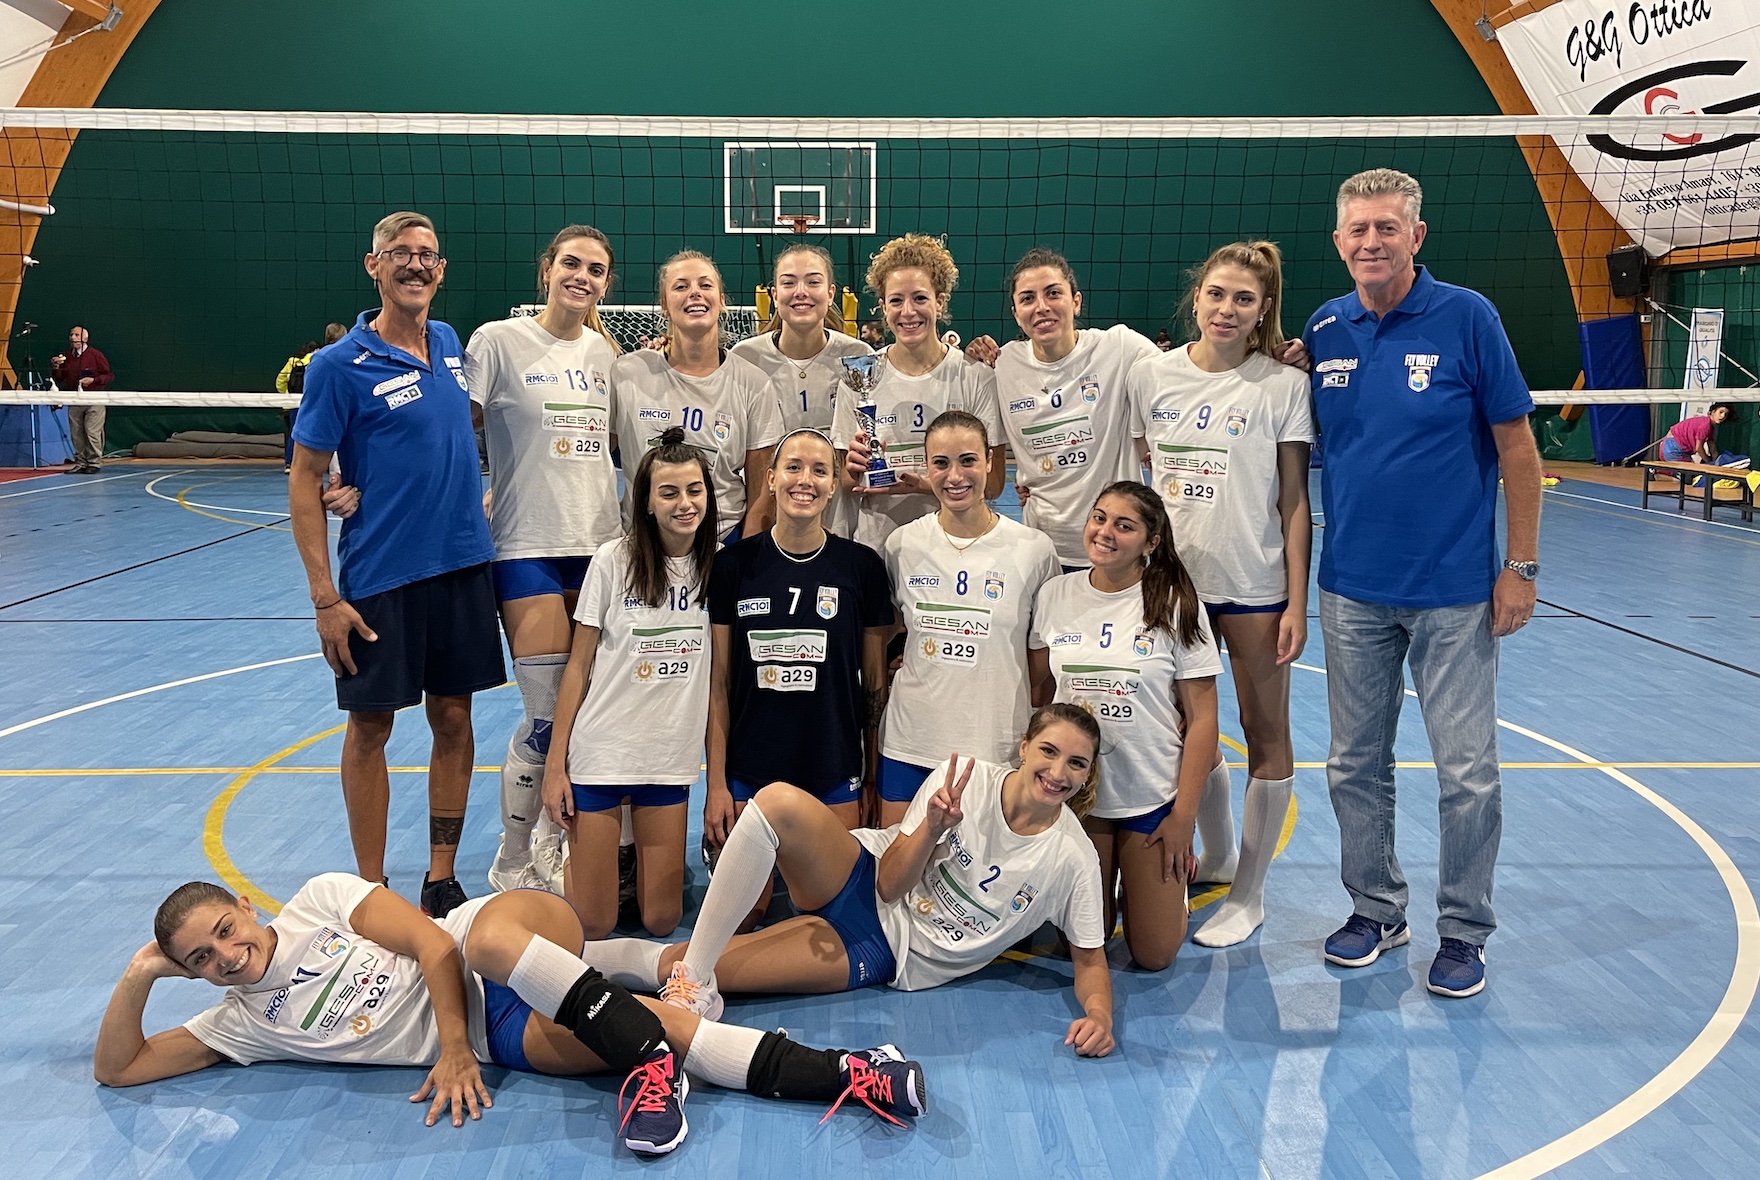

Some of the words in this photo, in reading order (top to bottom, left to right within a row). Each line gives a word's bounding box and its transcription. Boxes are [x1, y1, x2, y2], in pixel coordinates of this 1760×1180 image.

[1566, 10, 1623, 83] G&G
[1628, 0, 1712, 46] Ottica
[1620, 191, 1639, 203] Via
[1657, 196, 1682, 212] 091
[1683, 192, 1705, 205] 661
[525, 374, 558, 384] RMC101
[564, 368, 589, 392] 13
[799, 389, 808, 412] 1
[1009, 400, 1036, 412] RMC101
[1050, 388, 1063, 409] 6
[553, 414, 607, 427] GESAN
[640, 410, 671, 420] RMC101
[682, 405, 704, 432] 10
[874, 415, 897, 425] MC101
[913, 404, 925, 428] 3
[1152, 411, 1181, 421] RMC101
[1196, 404, 1213, 431] 9
[575, 439, 600, 453] a29
[1031, 428, 1092, 447] GESAN
[890, 454, 924, 464] GES
[1057, 451, 1088, 467] a29
[1164, 456, 1228, 471] GESAN
[1183, 483, 1215, 500] a29
[908, 577, 940, 586] RMC101
[956, 570, 969, 596] 8
[668, 585, 689, 612] 18
[738, 601, 770, 613] RMC101
[788, 586, 802, 616] 7
[921, 615, 989, 631] GESAN
[640, 638, 703, 650] GESAN
[1051, 635, 1082, 646] RMC101
[1100, 623, 1114, 649] 5
[759, 644, 824, 654] GESAN
[942, 642, 975, 658] a29
[658, 661, 689, 675] a29
[781, 669, 813, 683] a29
[1071, 677, 1139, 690] GESAN
[1100, 703, 1132, 718] a29
[978, 865, 1001, 893] 2
[935, 879, 991, 933] GESAN
[932, 917, 964, 942] a29
[319, 952, 375, 1029] GESAN
[362, 974, 390, 1009] a29
